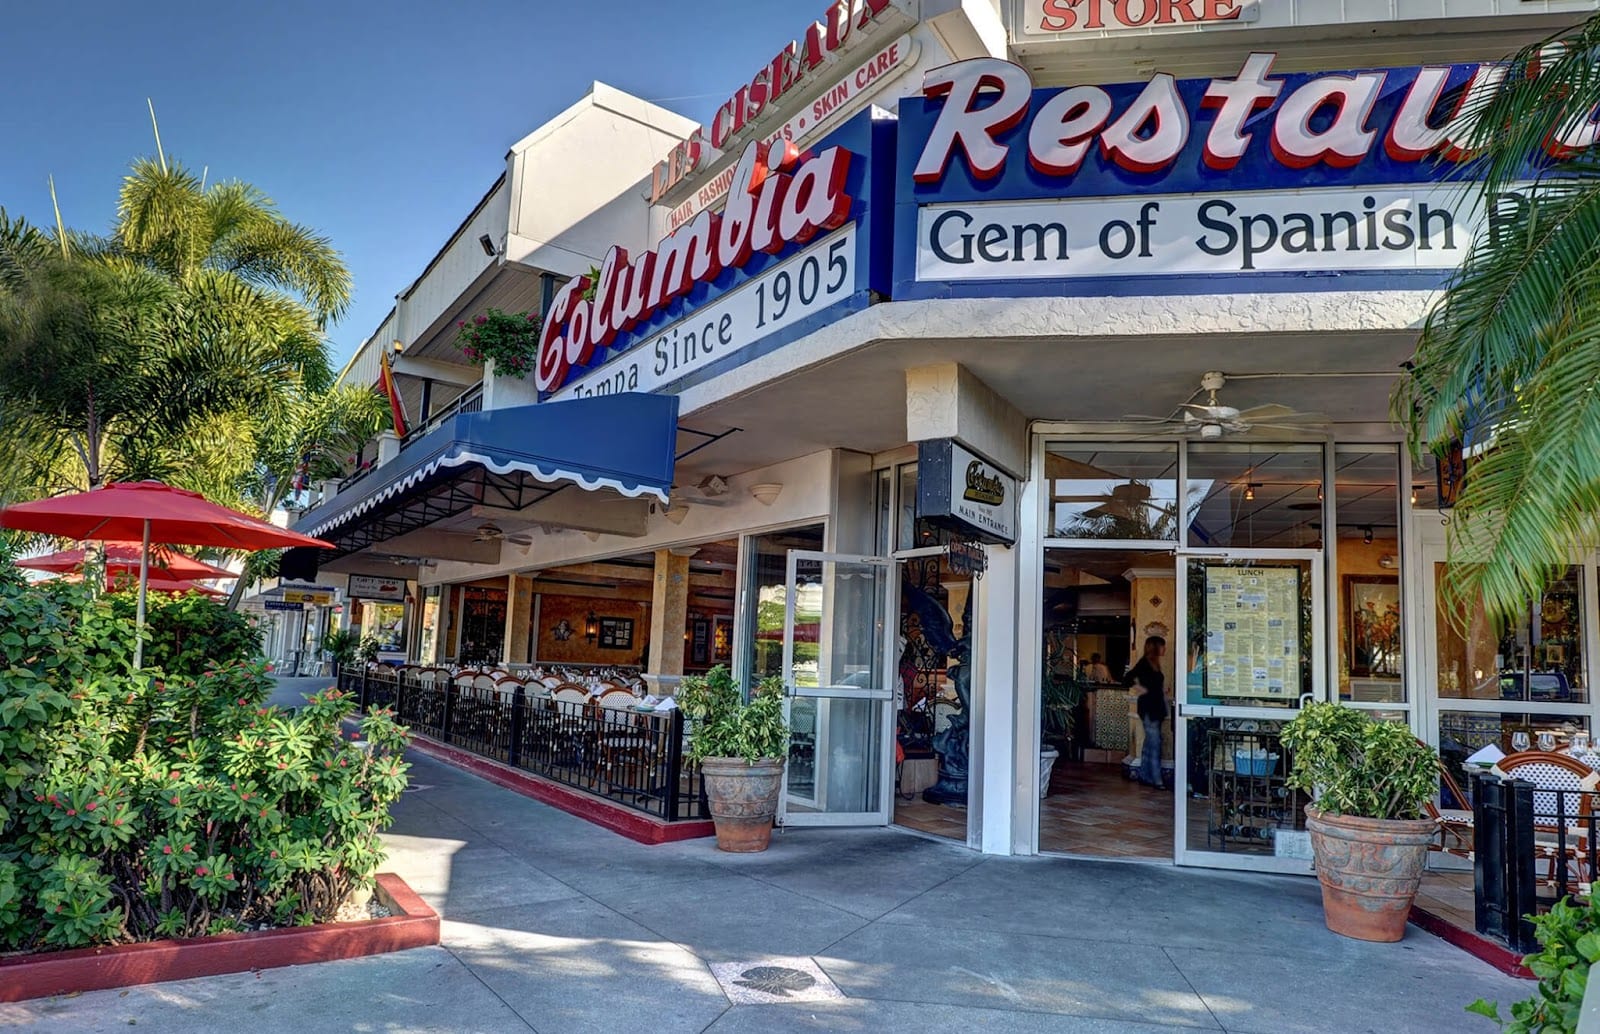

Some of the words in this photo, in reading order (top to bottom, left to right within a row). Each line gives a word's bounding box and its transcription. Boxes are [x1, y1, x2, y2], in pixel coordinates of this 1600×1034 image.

[670, 201, 694, 229] HAIR
[698, 164, 738, 206] FASHIO
[813, 81, 849, 121] SKIN
[855, 43, 899, 90] CARE
[912, 42, 1600, 183] Restau
[535, 139, 853, 393] Columbia
[930, 209, 1068, 264] Gem
[1098, 202, 1160, 259] of
[1195, 195, 1458, 270] Spanish
[654, 312, 733, 377] Since
[755, 237, 849, 329] 1905
[959, 505, 976, 519] MAIN
[978, 514, 1009, 535] ENTRANCE
